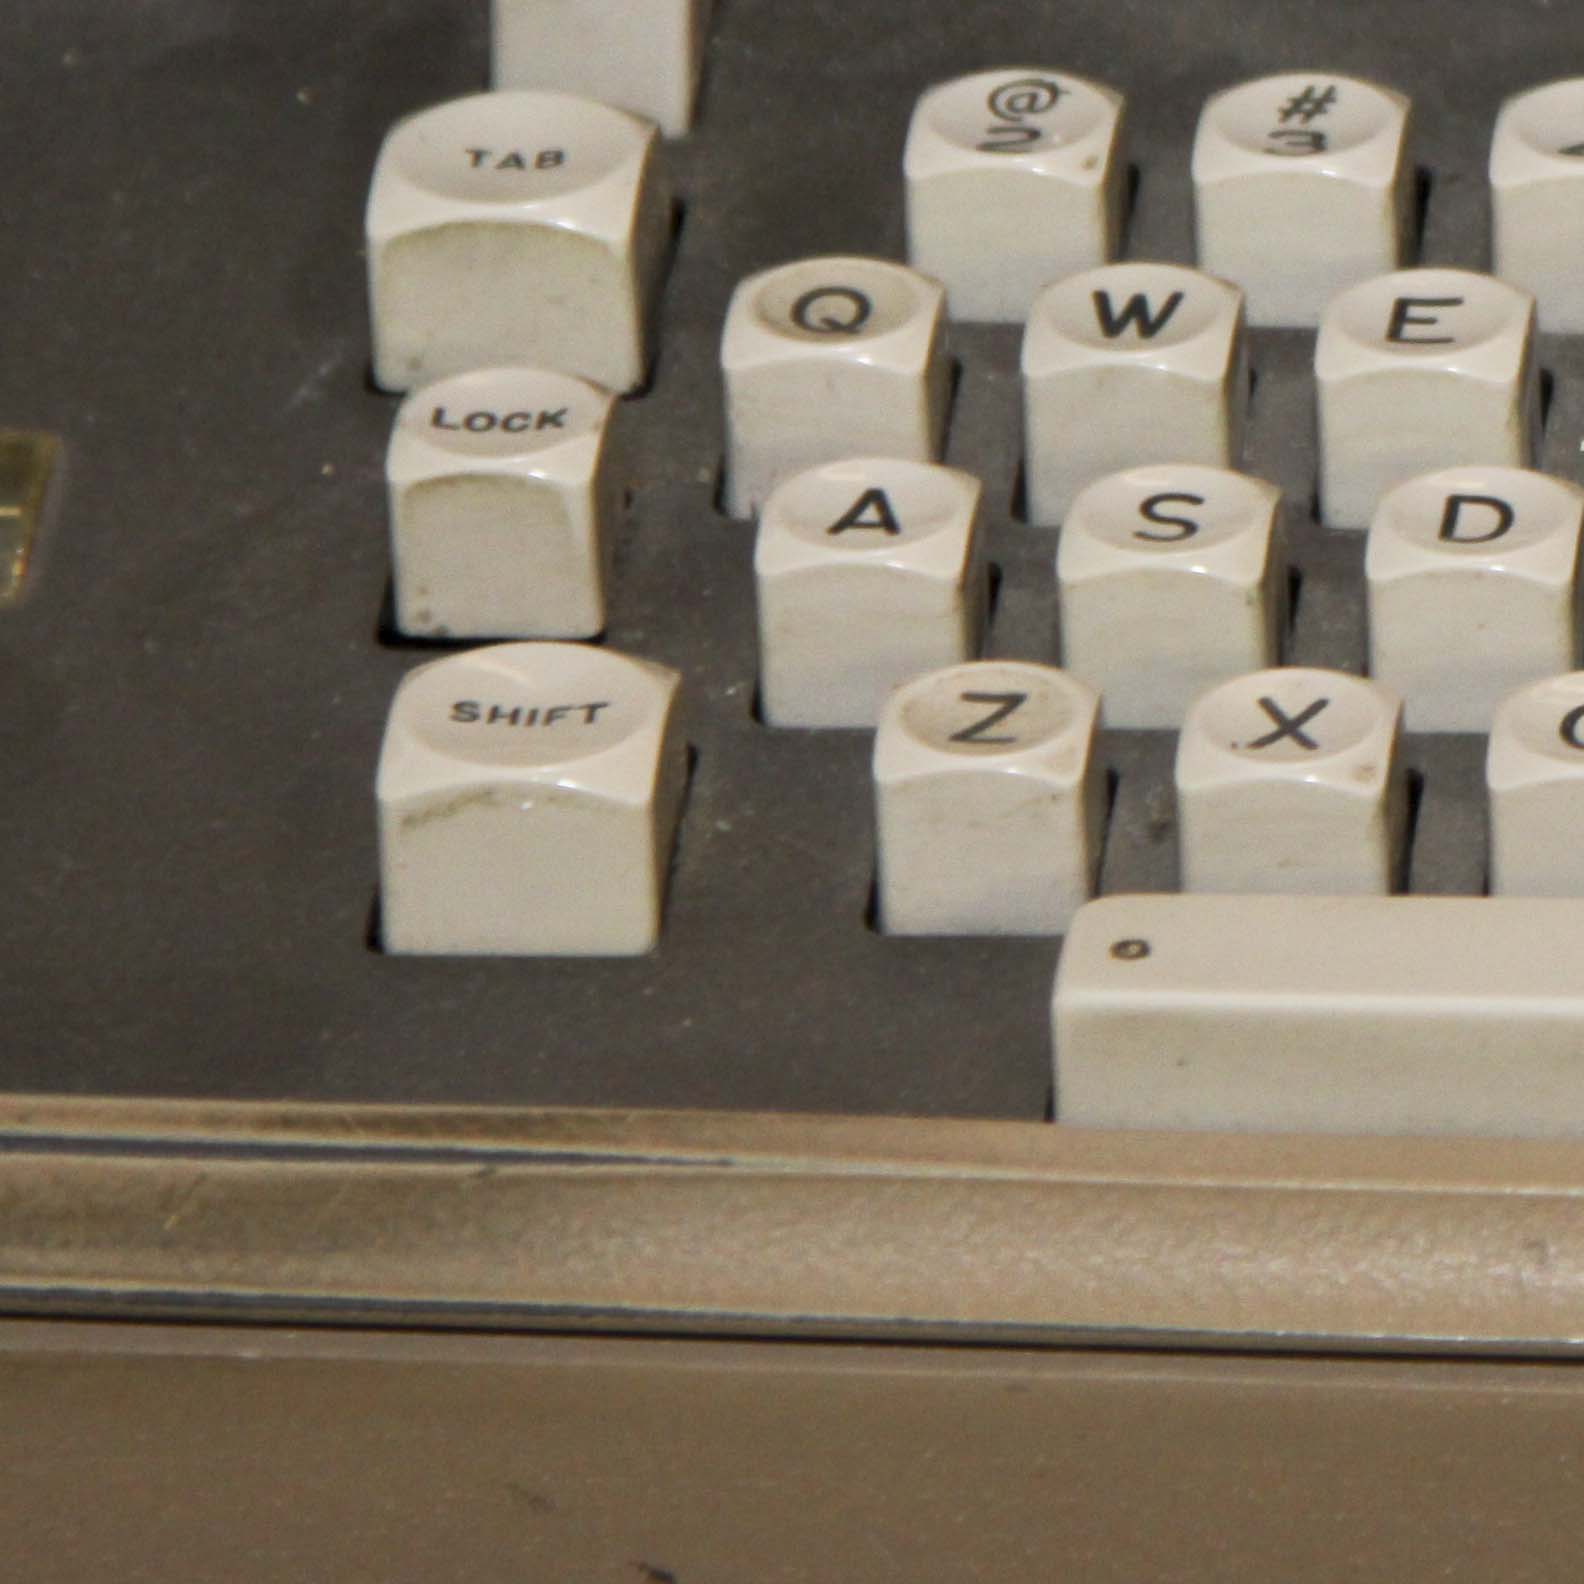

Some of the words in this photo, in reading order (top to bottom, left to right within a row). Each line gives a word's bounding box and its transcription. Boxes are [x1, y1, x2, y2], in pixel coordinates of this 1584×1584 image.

[987, 79, 1071, 119] @
[1278, 85, 1336, 126] #
[465, 148, 565, 172] TAB
[789, 286, 872, 334] Q
[1091, 290, 1184, 341] W
[1384, 297, 1463, 346] E
[429, 407, 567, 434] LOCK
[825, 488, 901, 537] A
[1132, 493, 1204, 544] S
[1437, 494, 1515, 544] D
[449, 701, 609, 728] SHIFT
[947, 692, 1027, 747] Z
[1245, 697, 1329, 752] X
